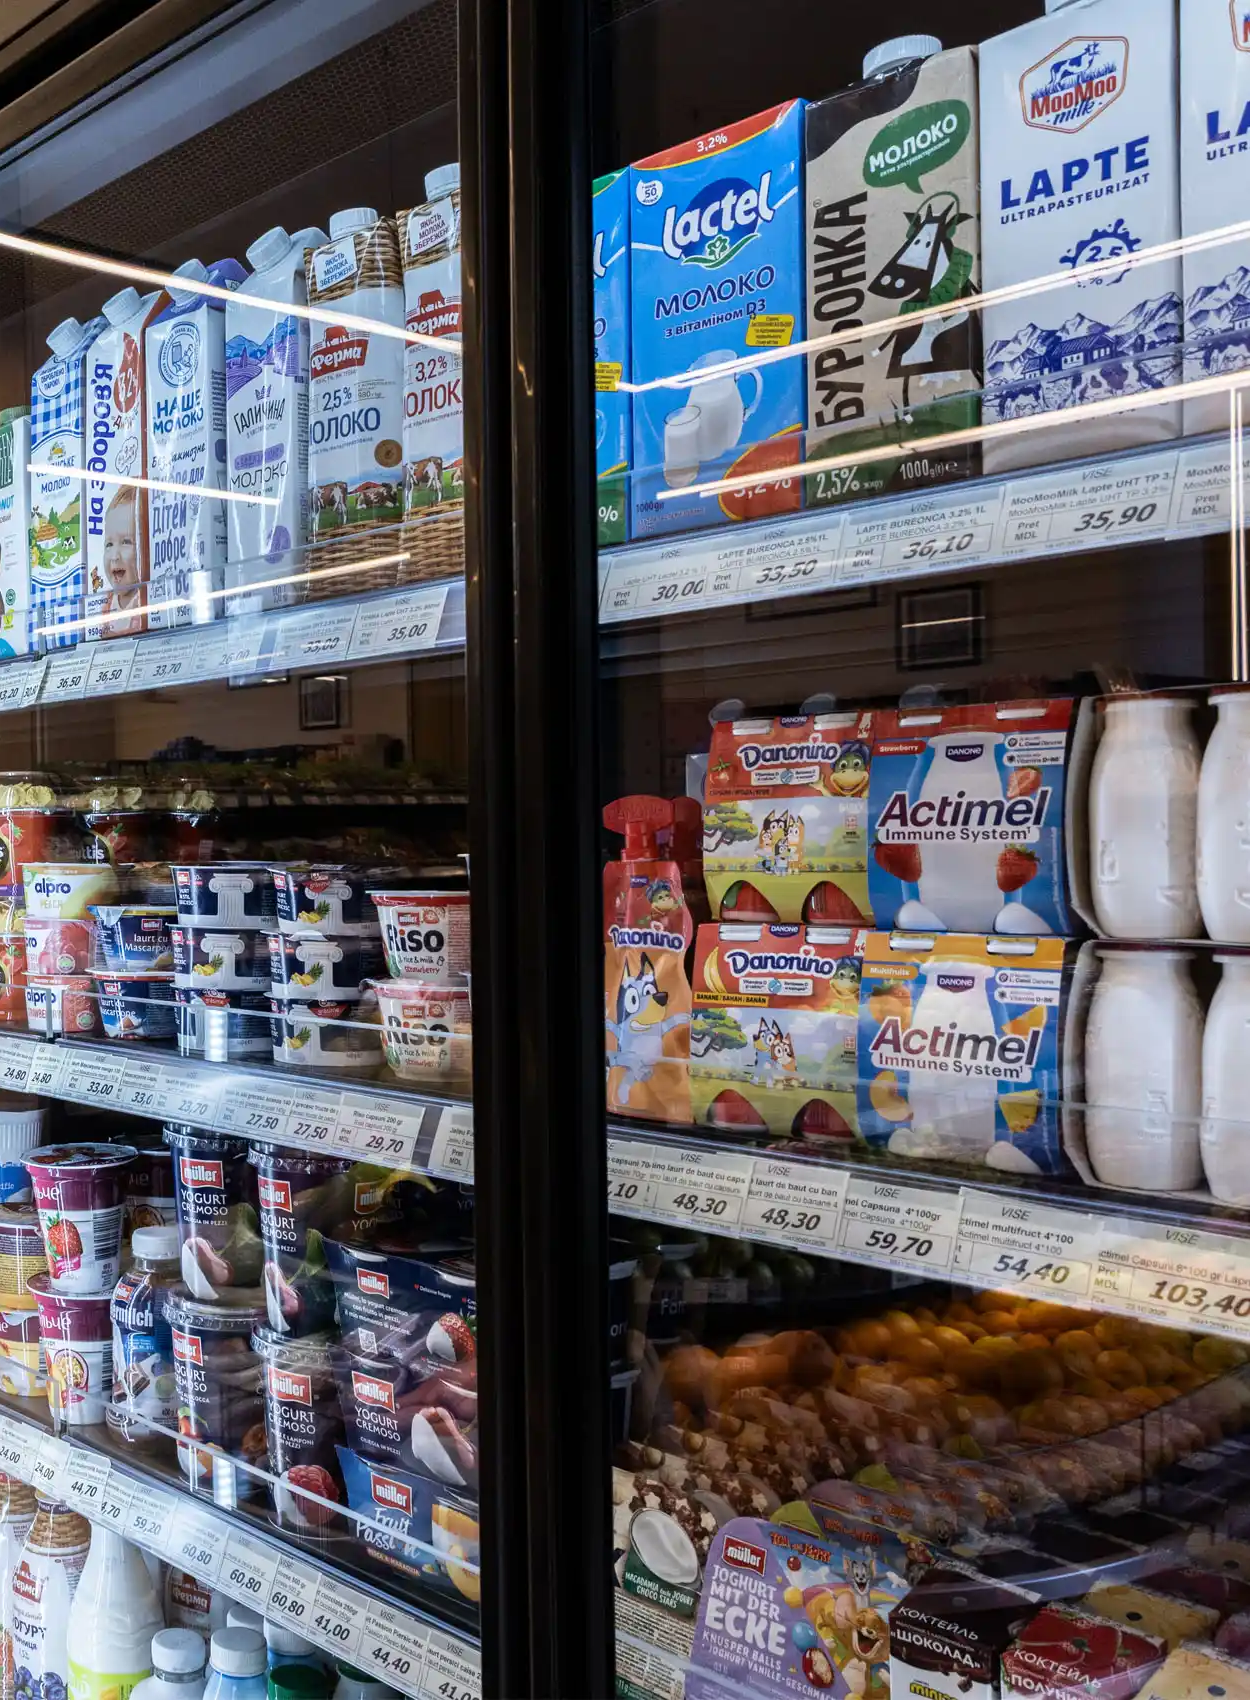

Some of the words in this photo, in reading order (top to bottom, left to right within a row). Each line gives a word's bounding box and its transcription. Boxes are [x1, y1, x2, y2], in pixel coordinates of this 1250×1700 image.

[1030, 75, 1117, 119] MooMoo
[1053, 101, 1095, 125] milk
[697, 134, 728, 152] 3,2%
[869, 113, 958, 174] МОЛОКО
[1001, 135, 1149, 210] LAPTE
[1001, 173, 1149, 225] ULTRAPASTEURIZAT
[419, 213, 442, 230] ЯКІСТЬ
[662, 171, 774, 260] lactel
[418, 220, 446, 239] МОЛОКА
[323, 258, 349, 277] МОЛОКА
[325, 252, 345, 267] ЯКІСТЬ
[655, 266, 775, 319] МОЛОКО
[675, 309, 743, 336] вітаміном
[311, 346, 363, 371] Ферма
[415, 355, 448, 382] 3,2%
[156, 388, 201, 419] НАШЕ
[322, 386, 352, 413] 2,5%
[153, 407, 204, 435] МОЛОКО
[233, 398, 286, 435] ГАЛИЧИНА
[41, 476, 70, 494] МОЛОКО
[230, 460, 288, 489] МОЛОКО
[816, 465, 860, 499] 2,5%
[1011, 489, 1079, 506] MooMooMilk
[1082, 482, 1113, 497] Lapte
[1116, 477, 1140, 488] UHT
[88, 494, 104, 536] На
[856, 525, 887, 536] LAPTE
[889, 515, 946, 530] BUREONCA
[1074, 503, 1157, 533] 35,90
[902, 532, 975, 560] 36,10
[1014, 531, 1038, 542] MDL
[746, 540, 796, 556] BUREONCA
[756, 559, 818, 585] 33,50
[652, 580, 704, 602] 30,00
[386, 622, 428, 642] 35,00
[96, 668, 122, 682] 36,50
[152, 662, 182, 677] 33,70
[56, 676, 81, 689] 36,50
[738, 738, 838, 770] Danonino
[880, 745, 919, 753] Strawberry
[948, 747, 982, 756] DANONE
[878, 790, 1051, 827] Actimel
[885, 829, 956, 840] Immune
[34, 878, 72, 897] alpro
[157, 935, 168, 943] cu
[386, 924, 444, 954] Riso
[771, 925, 798, 933] DANONE
[404, 966, 440, 975] strawberry
[419, 955, 435, 964] milk
[727, 946, 835, 975] Danonino
[939, 978, 974, 986] DANONE
[871, 1019, 1041, 1065] Actimel
[879, 1053, 949, 1071] Immune
[3, 1067, 27, 1081] 24,80
[31, 1071, 52, 1084] 24,80
[86, 1081, 114, 1095] 33,00
[246, 1113, 279, 1130] 27,50
[293, 1123, 328, 1140] 27,50
[365, 1134, 404, 1153] 29,70
[680, 1153, 703, 1164] VISE
[767, 1163, 792, 1176] VISE
[184, 1165, 217, 1182] müller
[180, 1189, 227, 1206] YOGURT
[787, 1182, 806, 1192] baut
[808, 1185, 819, 1194] cu
[821, 1186, 838, 1197] ban
[873, 1185, 901, 1199] VISE
[181, 1201, 228, 1216] CREMOSO
[672, 1193, 728, 1215] 48,30
[861, 1199, 900, 1214] Capsuna
[1000, 1206, 1032, 1221] VISE
[760, 1207, 821, 1231] 48,30
[991, 1220, 1042, 1240] multifruct
[865, 1230, 933, 1257] 59,70
[1166, 1229, 1201, 1245] VISE
[993, 1253, 1071, 1285] 54,40
[1131, 1254, 1173, 1272] Capsuni
[1210, 1271, 1221, 1281] gr
[360, 1274, 386, 1293] müller
[1094, 1278, 1119, 1290] MDL
[1149, 1281, 1250, 1318] 103,40
[271, 1381, 305, 1399] müller
[359, 1381, 390, 1404] müller
[268, 1402, 315, 1424] YOGURT
[268, 1413, 316, 1435] CREMOSO
[355, 1405, 399, 1431] YOGURT
[356, 1418, 401, 1442] CREMOSO
[34, 1461, 54, 1480] 24,00
[70, 1480, 97, 1498] 44,70
[375, 1483, 407, 1507] müller
[133, 1515, 161, 1536] 59,20
[182, 1543, 212, 1565] 60,80
[727, 1545, 762, 1567] müller
[229, 1568, 262, 1593] 60,80
[712, 1565, 777, 1600] JOGHURT
[272, 1591, 305, 1617] 60,80
[636, 1586, 658, 1602] CHOCO
[710, 1581, 746, 1604] MIT
[747, 1595, 781, 1621] DER
[379, 1608, 396, 1623] VISE
[704, 1597, 787, 1656] ECKE
[899, 1606, 979, 1641] КОКТЕЙЛЬ
[314, 1614, 350, 1641] 41,00
[371, 1646, 411, 1675] 44,40
[446, 1642, 463, 1657] VISE
[702, 1631, 750, 1658] KNUSPER
[751, 1649, 782, 1670] BALLS
[708, 1645, 747, 1667] JOGHURT
[1014, 1649, 1101, 1688] КОКТЕЙЛЬ
